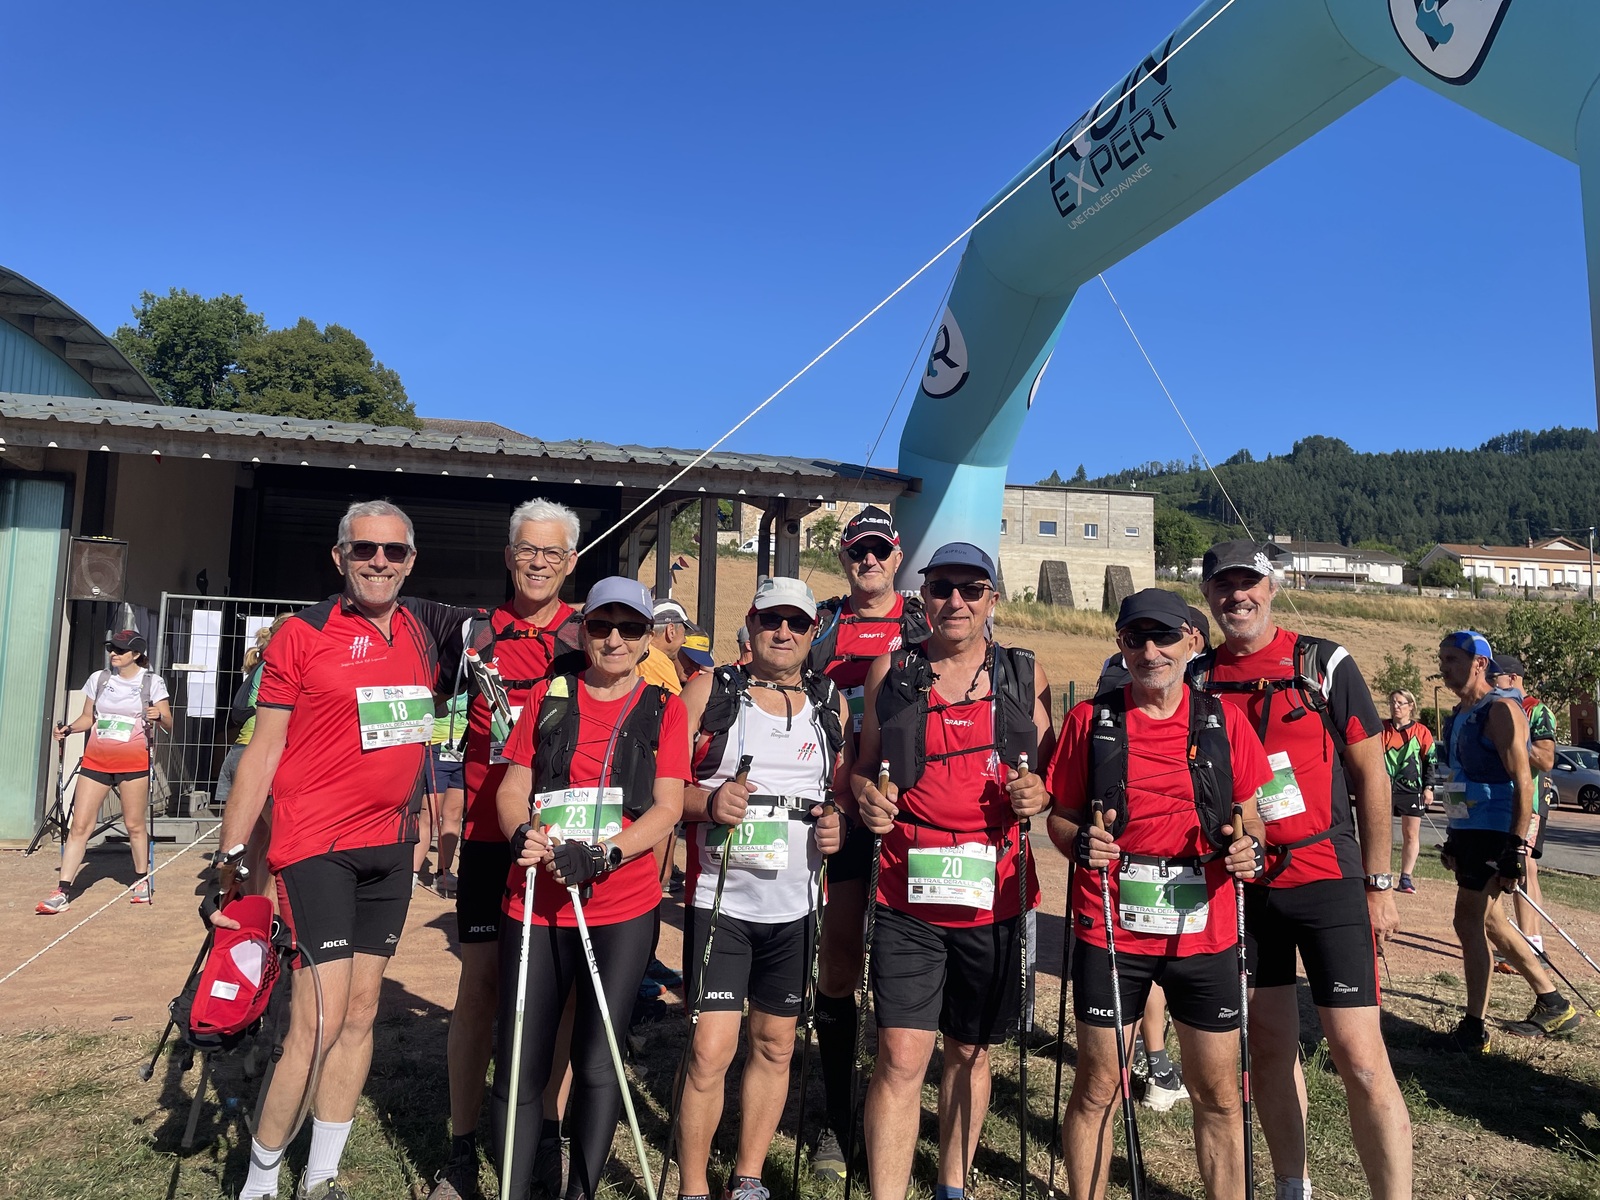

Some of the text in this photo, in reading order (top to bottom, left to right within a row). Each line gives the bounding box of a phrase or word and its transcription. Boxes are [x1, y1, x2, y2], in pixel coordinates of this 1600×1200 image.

[1051, 84, 1177, 218] EXPERT
[1068, 163, 1153, 230] UNE FOULÉE D'AVANCE
[388, 701, 408, 721] 18
[108, 720, 118, 730] 26
[944, 718, 968, 726] CRAFT
[564, 790, 589, 799] RUN
[565, 806, 586, 828] 23
[736, 823, 754, 844] 19
[942, 857, 962, 878] 20
[1155, 885, 1175, 907] 21
[320, 939, 348, 949] JOCEL
[585, 938, 599, 974] LEKI
[705, 992, 734, 1000] JOCEL
[1087, 1007, 1114, 1017] JOCE
